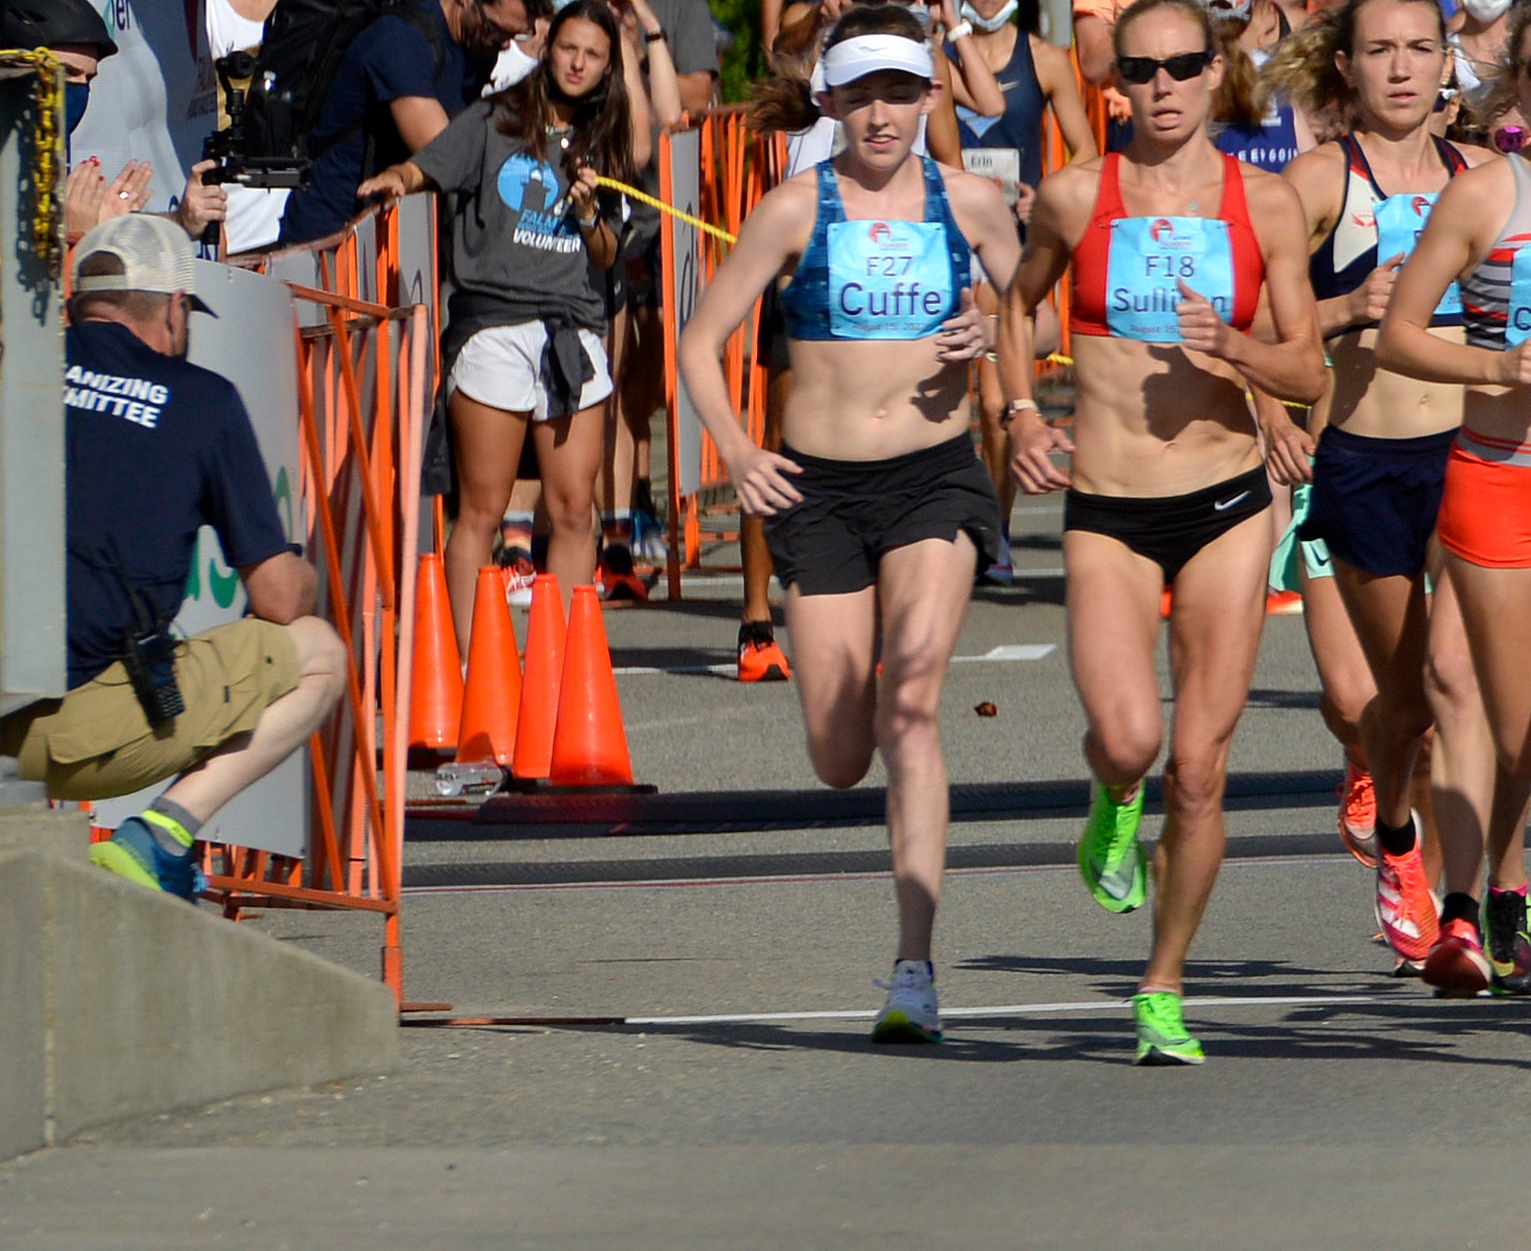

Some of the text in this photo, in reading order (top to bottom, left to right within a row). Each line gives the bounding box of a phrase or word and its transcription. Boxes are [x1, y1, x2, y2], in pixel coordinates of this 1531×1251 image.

[866, 255, 913, 277] F27
[1144, 255, 1195, 278] F18
[840, 282, 942, 317] Cuffe
[1113, 287, 1227, 313] Sullin
[1129, 323, 1160, 335] August
